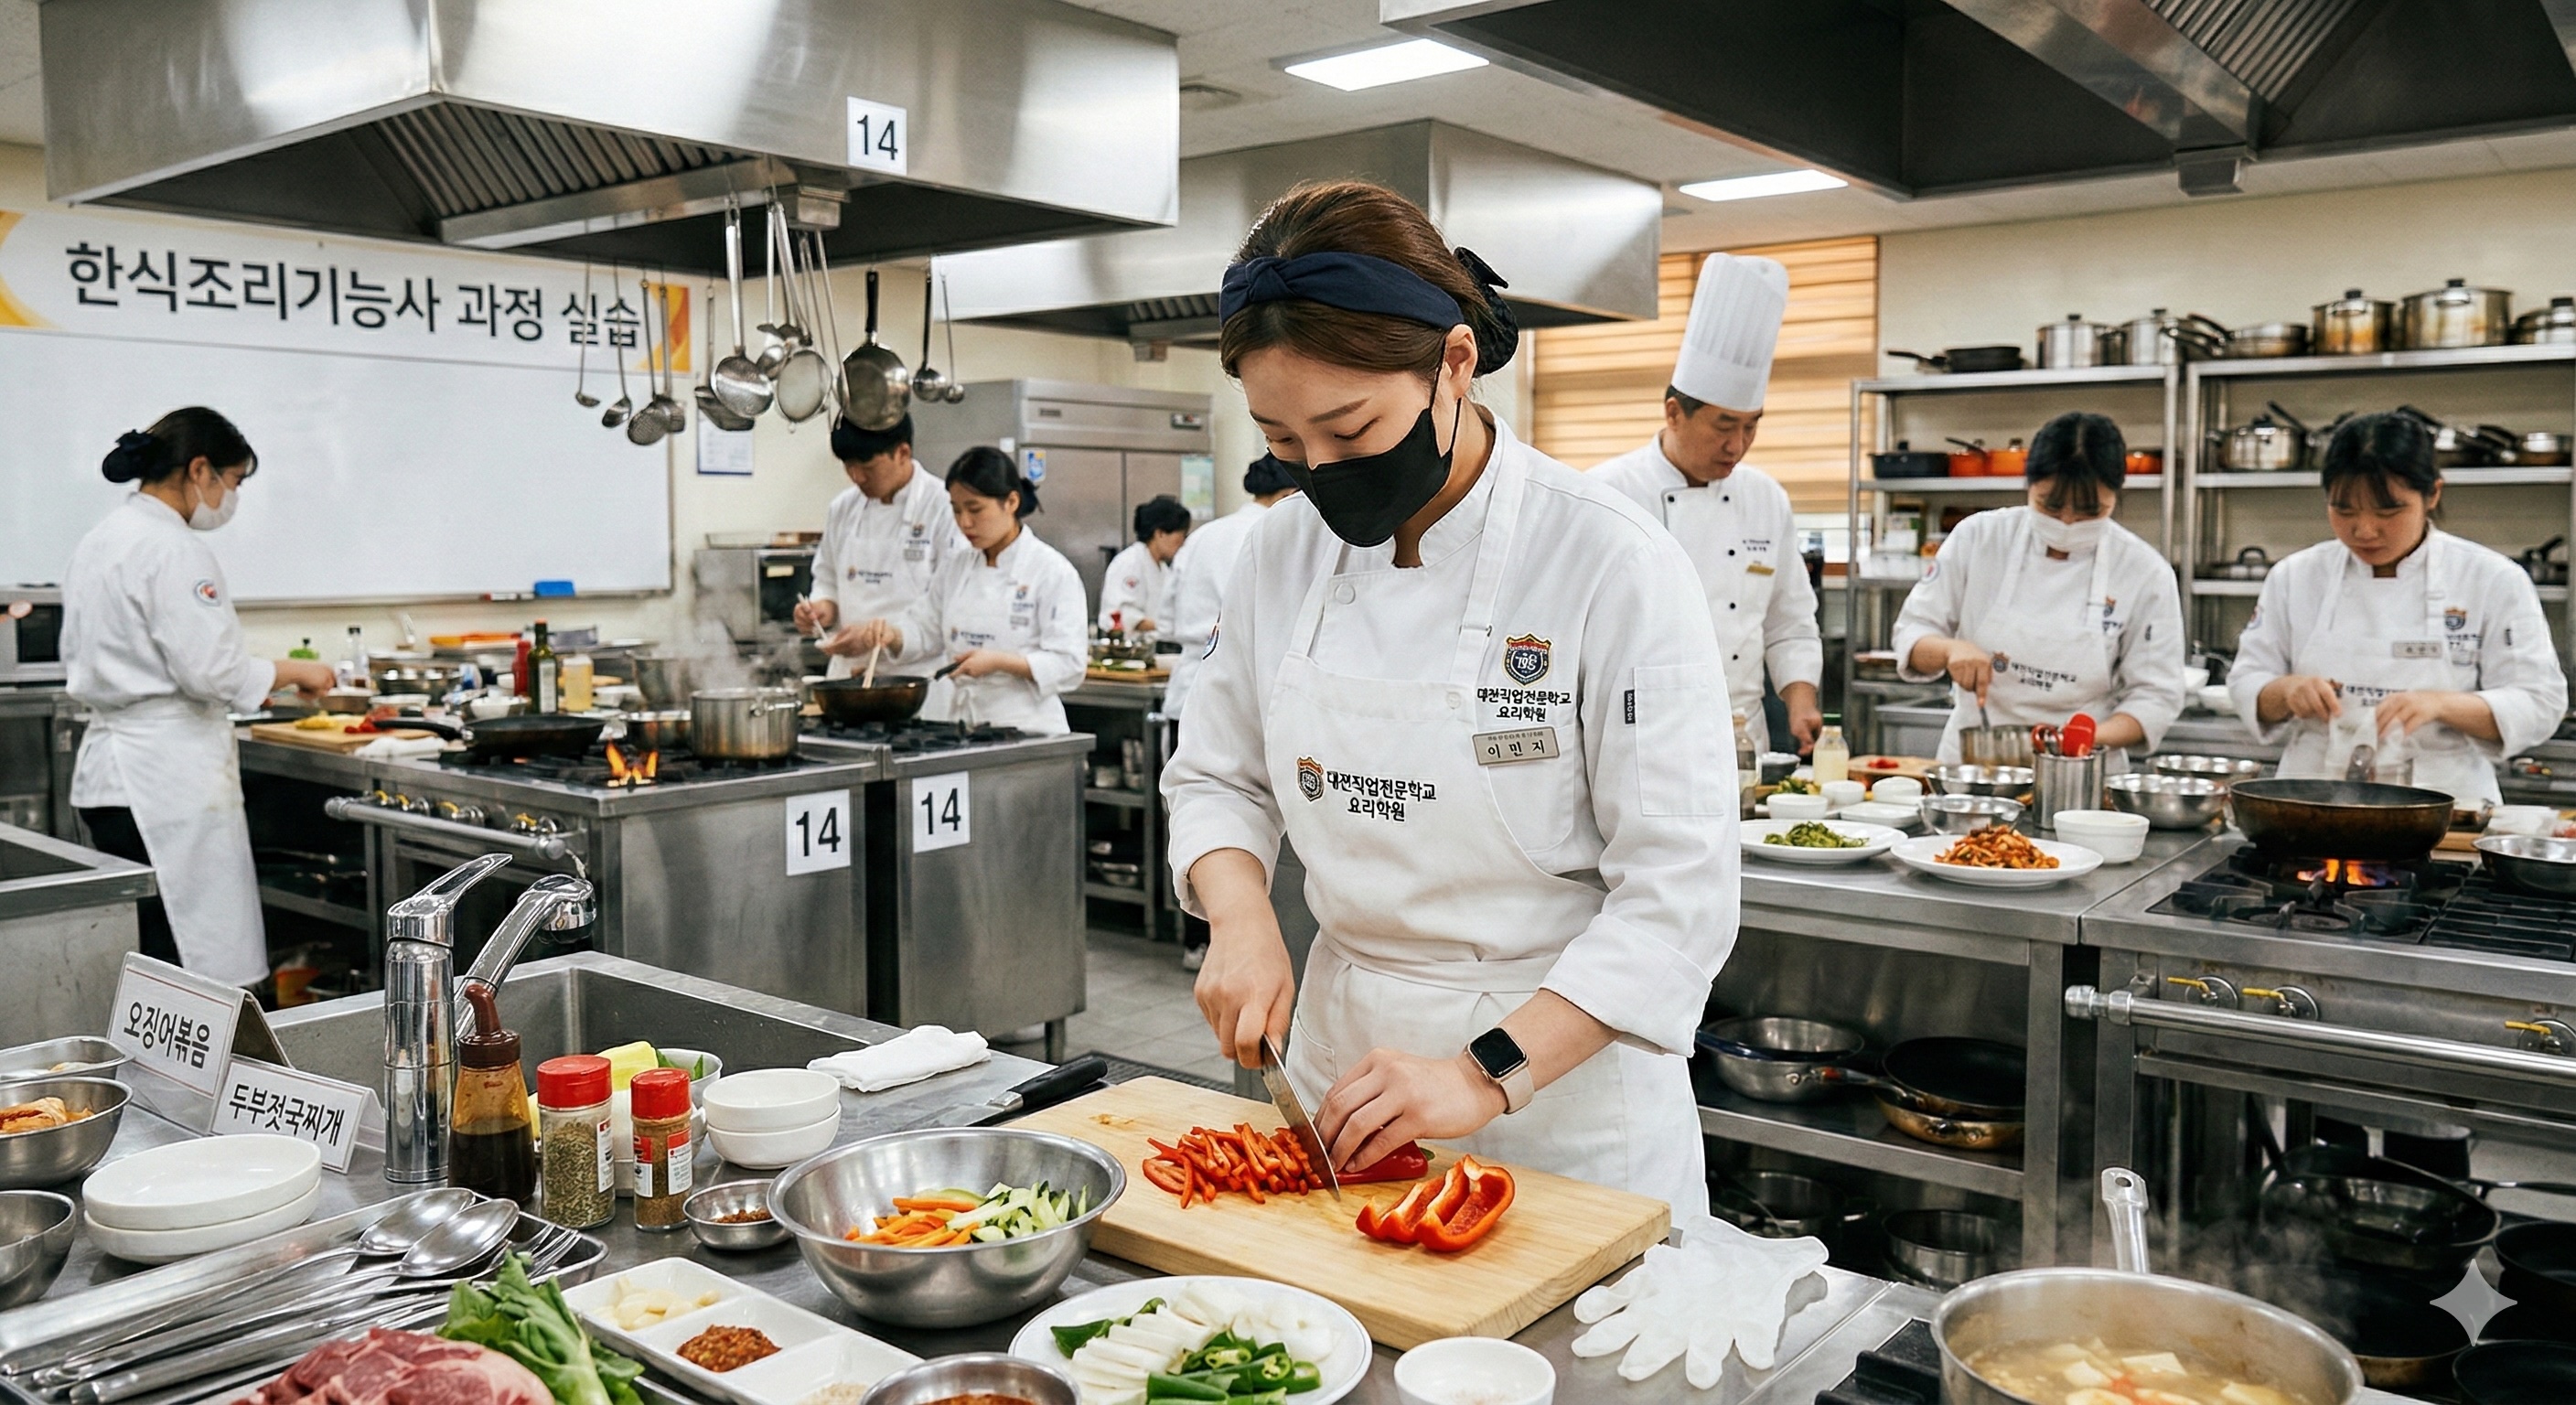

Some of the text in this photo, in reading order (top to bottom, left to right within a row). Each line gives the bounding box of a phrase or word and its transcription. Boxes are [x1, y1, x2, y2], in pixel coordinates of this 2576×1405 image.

[857, 113, 898, 160] 14
[65, 241, 640, 349] 한식조리기능사 과정 실습
[795, 806, 842, 858] 14
[920, 787, 962, 836] 14
[123, 1001, 211, 1069] 오징어볶음
[228, 1082, 346, 1148] 두부젓국찌개
